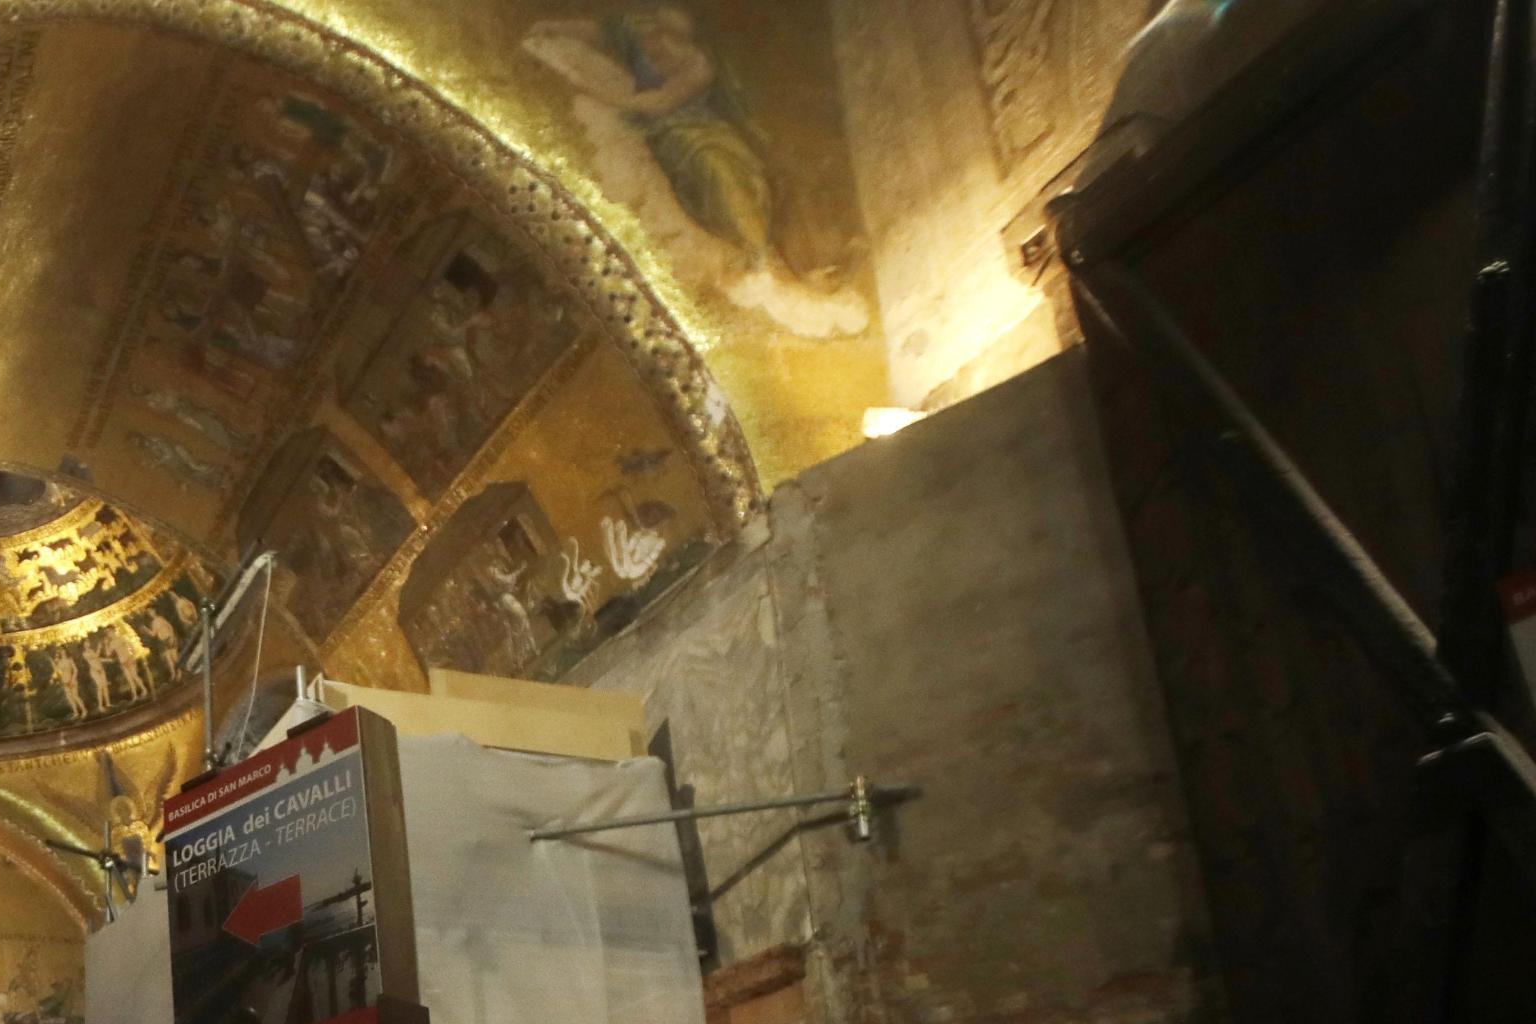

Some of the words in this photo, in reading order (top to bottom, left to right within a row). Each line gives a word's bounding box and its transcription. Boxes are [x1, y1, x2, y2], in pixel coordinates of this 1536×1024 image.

[168, 797, 205, 821] BASILICA
[207, 790, 217, 803] DI
[219, 781, 237, 798] SAN
[238, 764, 272, 788] MARCO
[173, 825, 235, 868] LOGGIA
[243, 806, 269, 834] dei
[273, 770, 352, 820] CAVALLI
[174, 838, 261, 893] (TERRAZZA
[276, 796, 357, 845] TERRACE)
